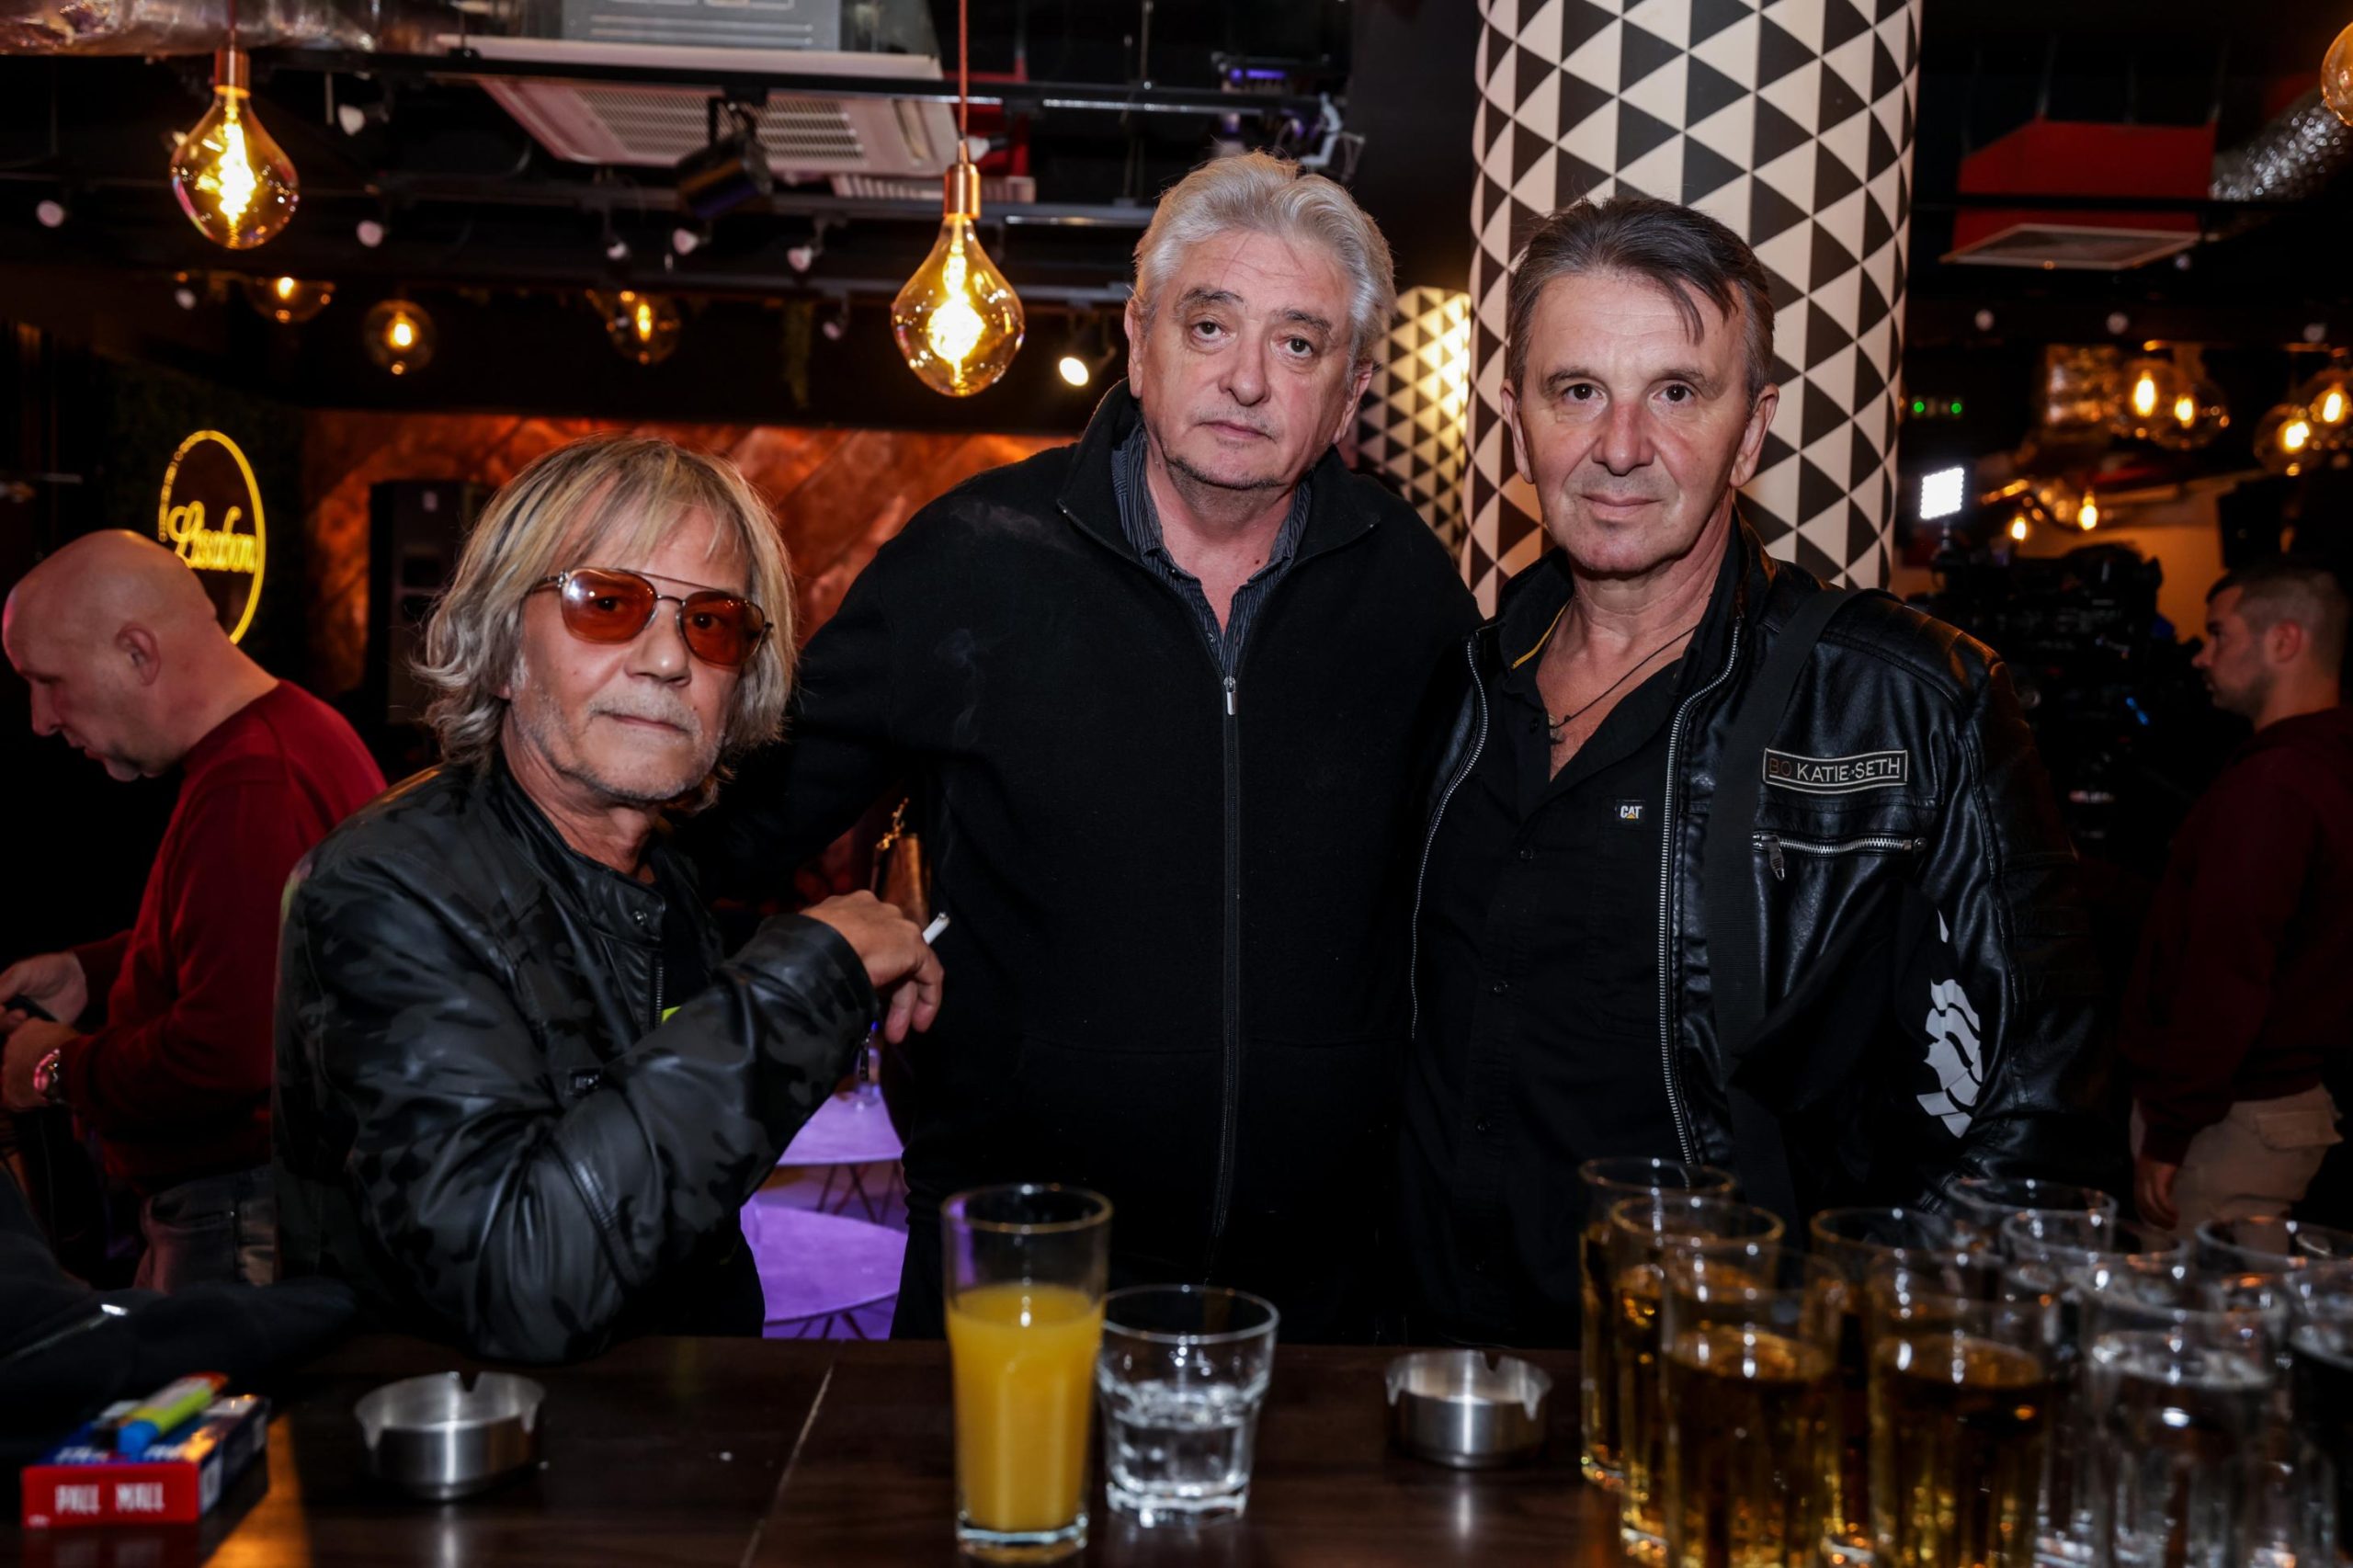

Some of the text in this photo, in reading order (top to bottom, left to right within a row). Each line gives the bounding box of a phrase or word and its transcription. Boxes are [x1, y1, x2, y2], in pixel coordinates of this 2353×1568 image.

[1768, 757, 1792, 777] BO
[1620, 805, 1643, 820] CAT
[55, 1482, 165, 1515] PALL MALL
